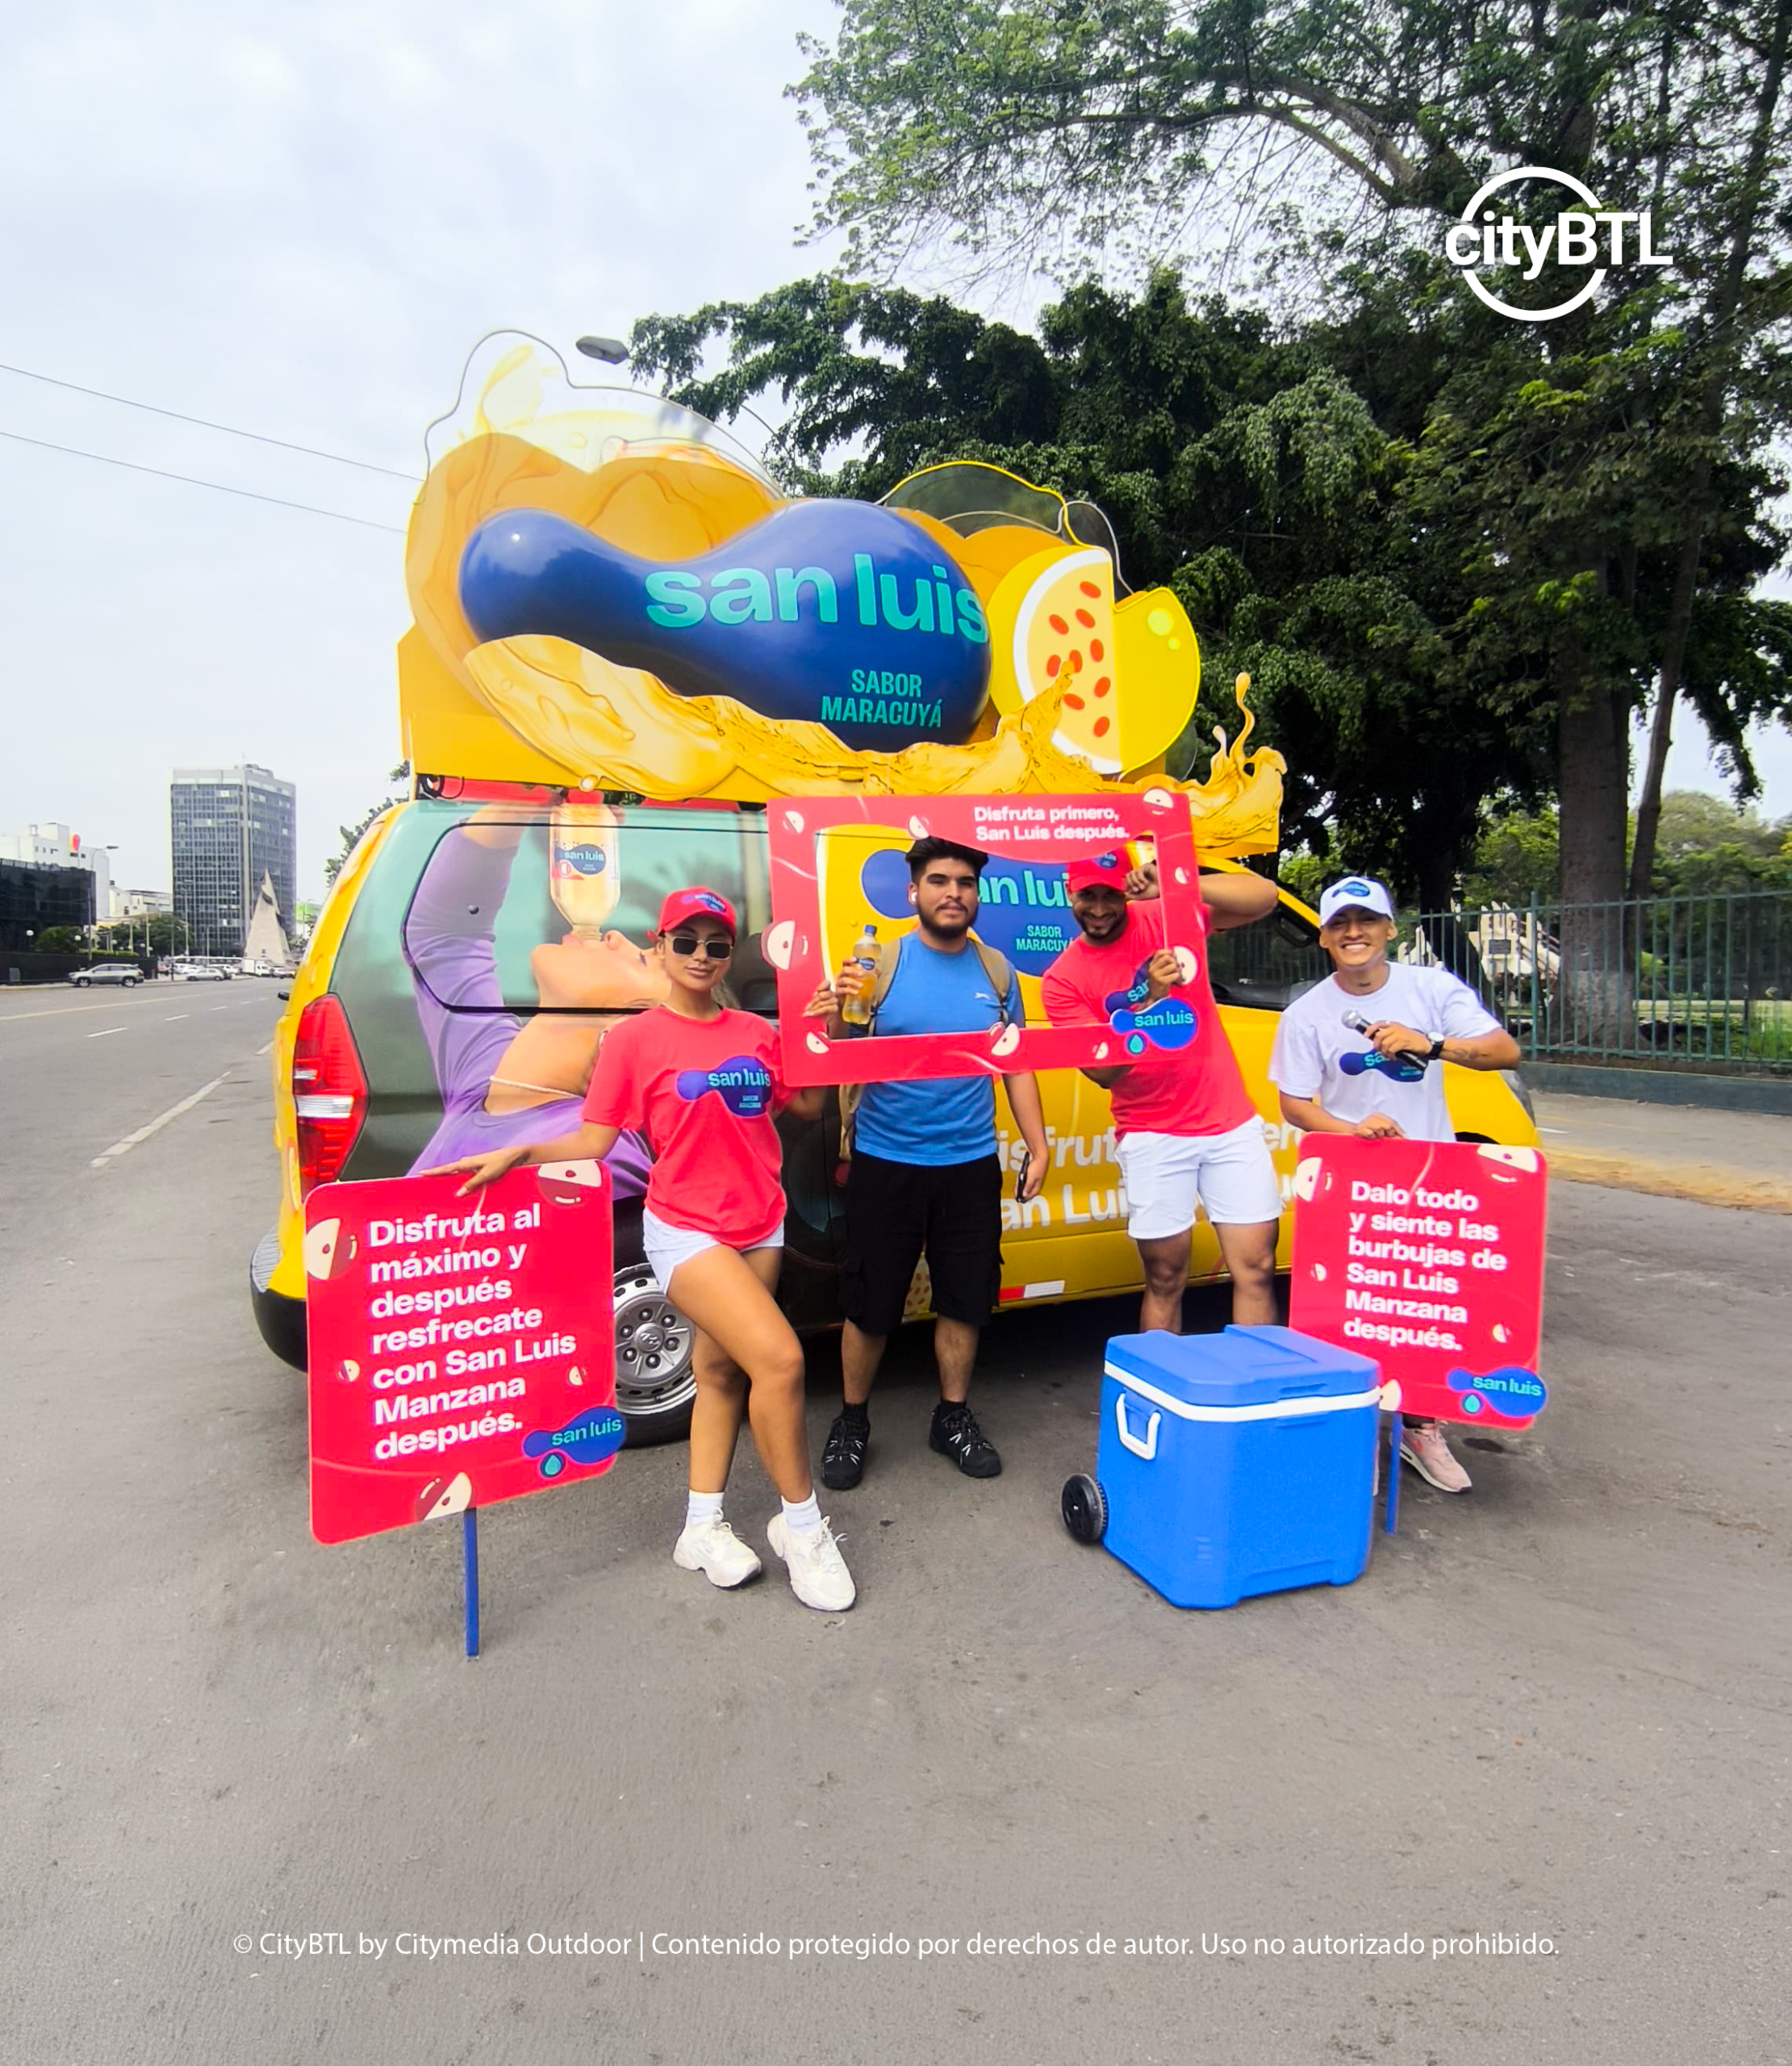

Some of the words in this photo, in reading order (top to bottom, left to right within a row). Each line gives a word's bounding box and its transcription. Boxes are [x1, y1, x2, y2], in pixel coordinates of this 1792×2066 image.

[645, 565, 839, 629] san
[854, 553, 989, 643] luis
[850, 668, 922, 698] SABOR
[821, 695, 942, 729] MARACUYÁ
[974, 805, 1046, 822] Disfruta
[1050, 806, 1119, 824] primero,
[975, 826, 1010, 841] San
[1013, 825, 1051, 841] Luis
[1054, 824, 1130, 843] después.
[585, 850, 604, 862] luis
[1016, 937, 1073, 951] MARACUY
[1027, 925, 1062, 938] SABOR
[1134, 1014, 1164, 1027] san
[1166, 1010, 1194, 1025] luis
[708, 1071, 742, 1087] san
[742, 1069, 771, 1087] luis
[1000, 1194, 1051, 1232] an
[1062, 1179, 1129, 1224] Lui
[1351, 1181, 1410, 1205] Dalo
[1415, 1188, 1479, 1211] todo
[368, 1211, 504, 1248] Disfruta
[513, 1203, 541, 1228] al
[1349, 1212, 1366, 1233] y
[1371, 1211, 1452, 1237] siente
[1459, 1219, 1500, 1242] las
[370, 1245, 501, 1283] máximo
[507, 1243, 528, 1270] y
[1347, 1236, 1466, 1269] burbujas
[1472, 1248, 1508, 1271] de
[1347, 1262, 1397, 1288] San
[1402, 1268, 1460, 1294] Luis
[370, 1276, 512, 1319] después
[1344, 1289, 1468, 1324] Manzana
[372, 1307, 544, 1355] resfrecate
[1343, 1317, 1464, 1352] después.
[373, 1358, 437, 1390] con
[445, 1347, 508, 1377] San
[515, 1332, 577, 1362] Luis
[374, 1376, 527, 1426] Manzana
[1472, 1376, 1507, 1392] san
[1509, 1377, 1543, 1397] luis
[374, 1411, 523, 1461] después.
[551, 1425, 587, 1447] san
[589, 1418, 623, 1437] luis
